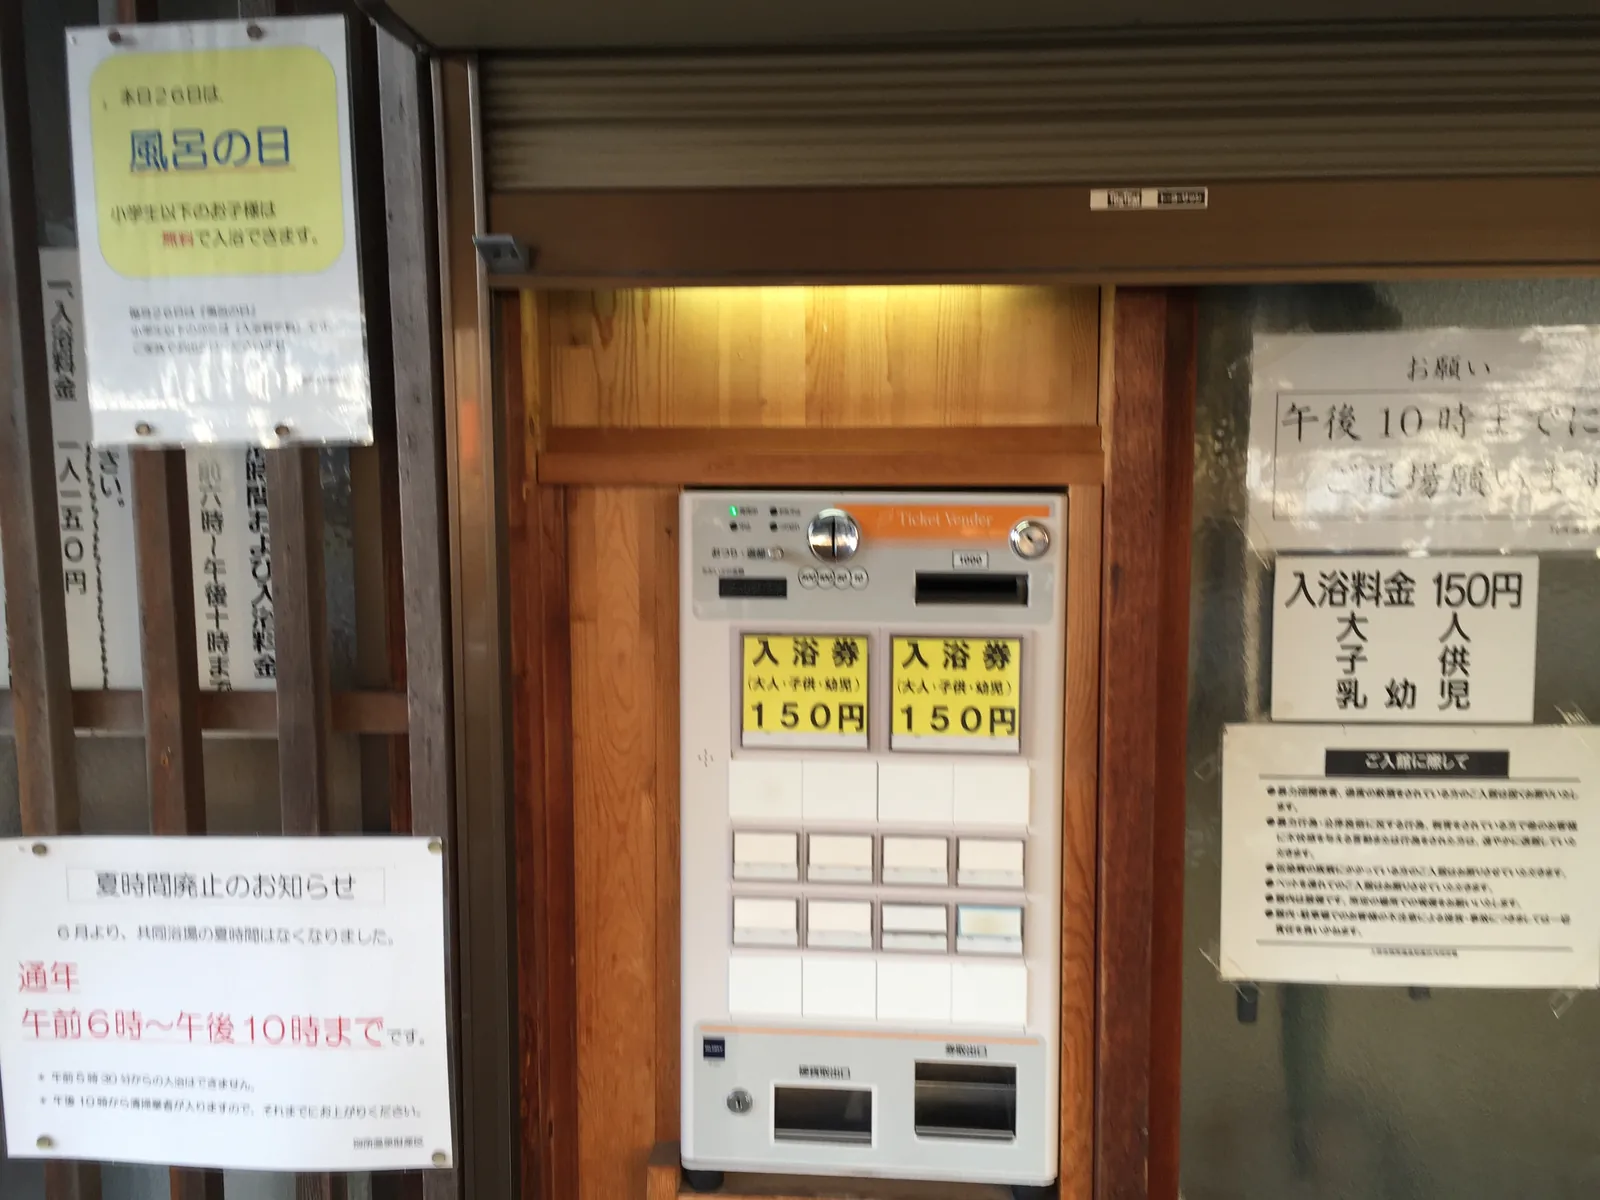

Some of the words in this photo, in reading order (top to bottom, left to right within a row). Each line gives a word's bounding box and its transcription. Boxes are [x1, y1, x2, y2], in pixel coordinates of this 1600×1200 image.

[129, 125, 292, 173] 風呂の日
[1407, 353, 1491, 382] お願い
[898, 509, 941, 527] Ticket
[945, 510, 994, 528] Vender
[1284, 568, 1417, 609] 入浴料金
[1433, 572, 1524, 609] 150円
[751, 635, 861, 669] 入浴券
[901, 638, 1013, 672] 入浴券
[1335, 678, 1472, 711] 乳幼児
[751, 701, 865, 732] 150円
[900, 704, 1017, 735] 150円
[95, 869, 357, 902] 夏時間廃止のお知らせ
[18, 959, 80, 994] 通年
